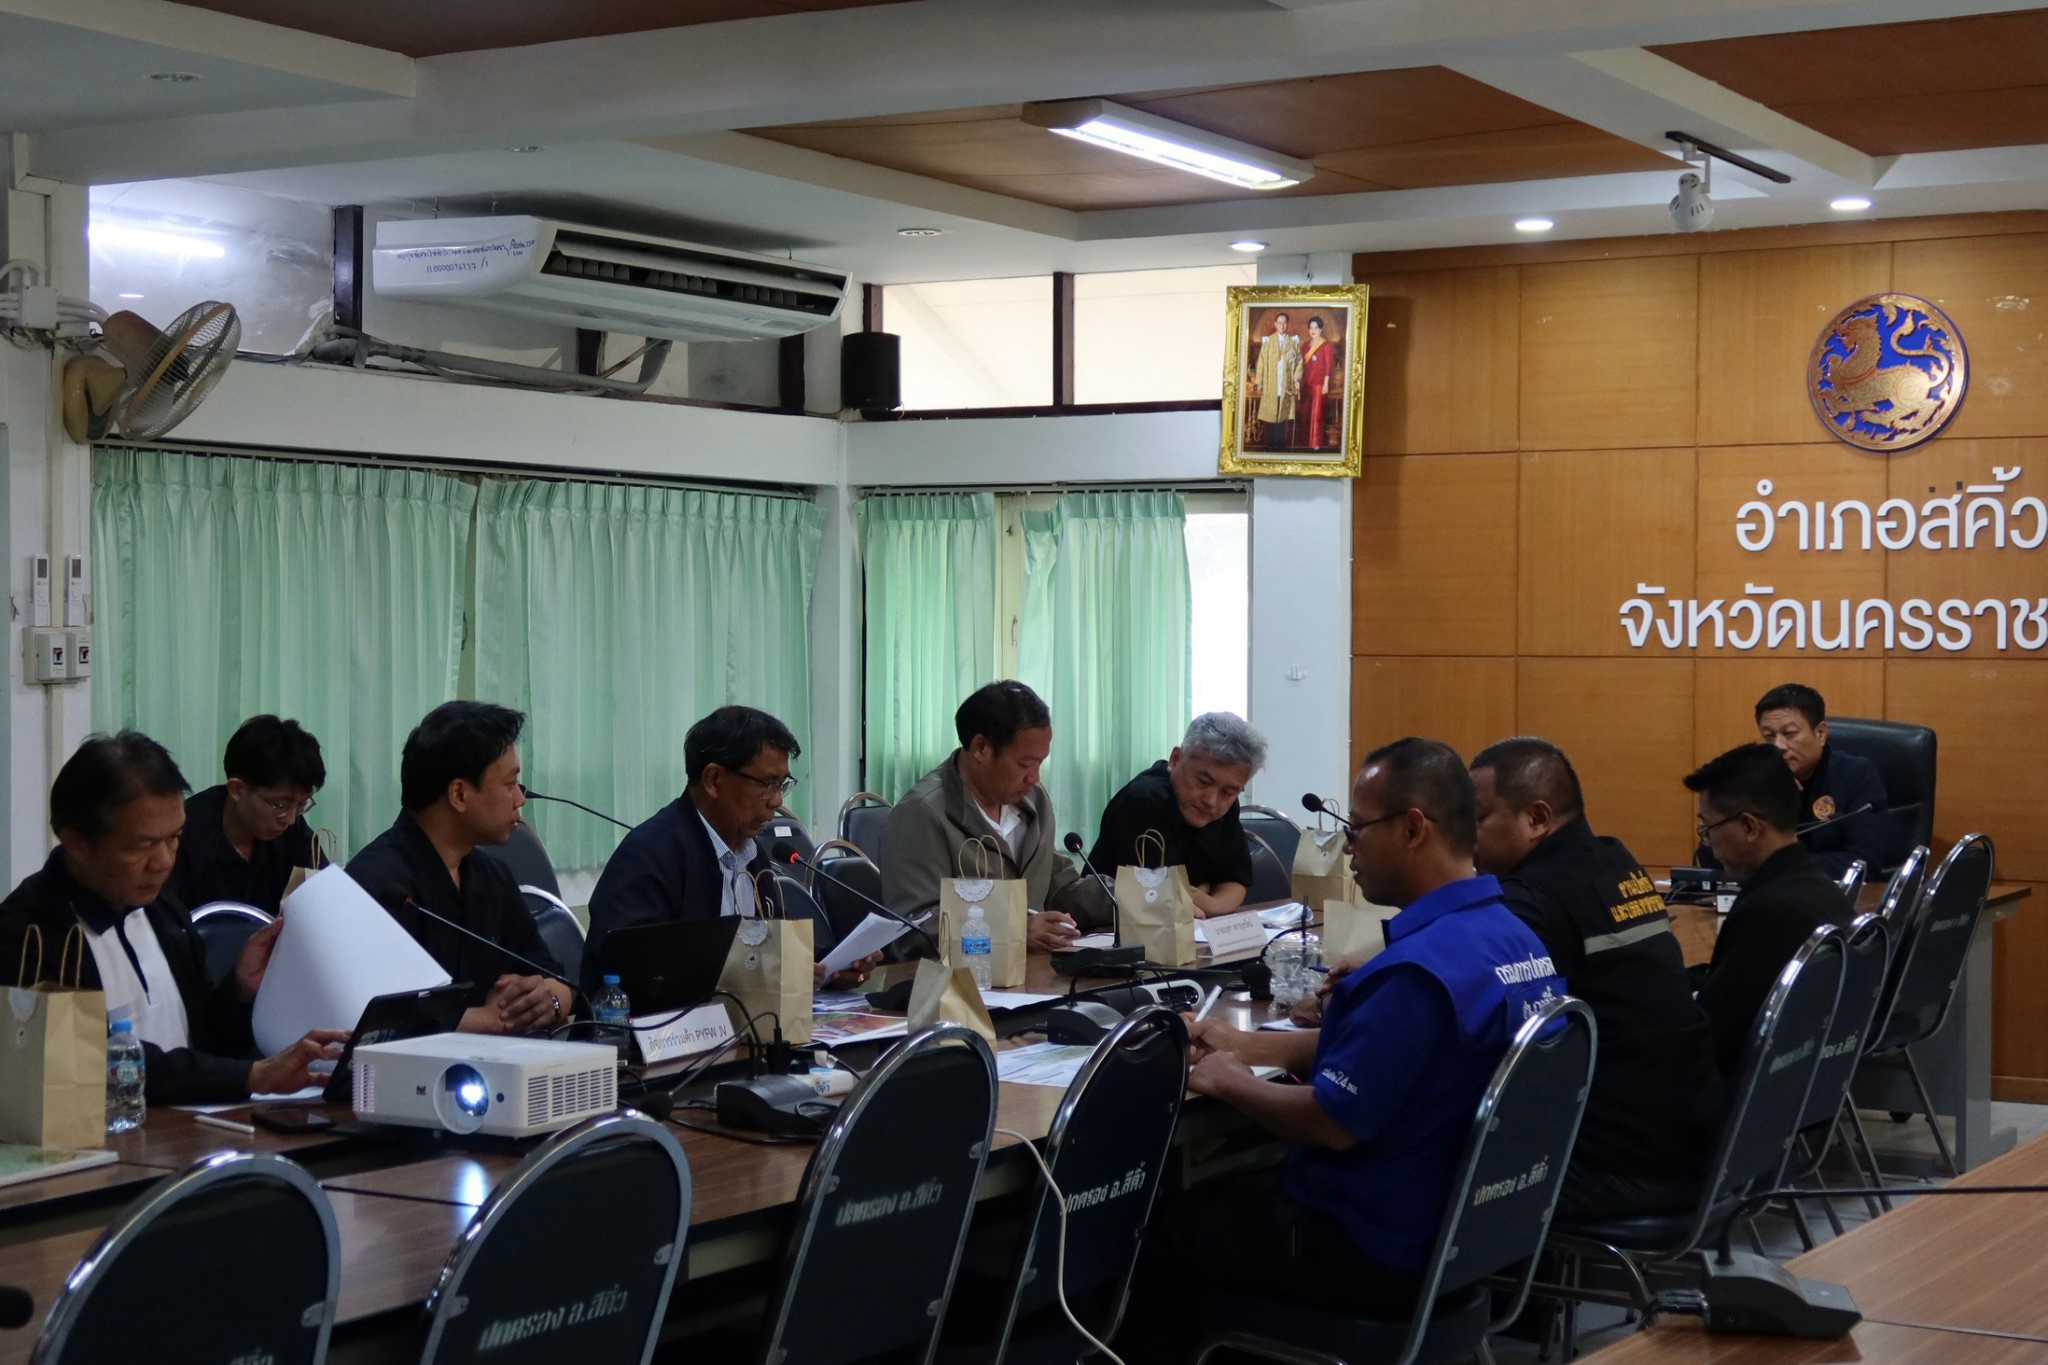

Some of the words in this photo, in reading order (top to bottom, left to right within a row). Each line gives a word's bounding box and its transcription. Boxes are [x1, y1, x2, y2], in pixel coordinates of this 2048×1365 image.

[1736, 466, 2048, 551] อำเภอสคิ้ว
[1619, 582, 2048, 651] จังหวัดนครราช
[478, 1306, 565, 1350] ปกครอง
